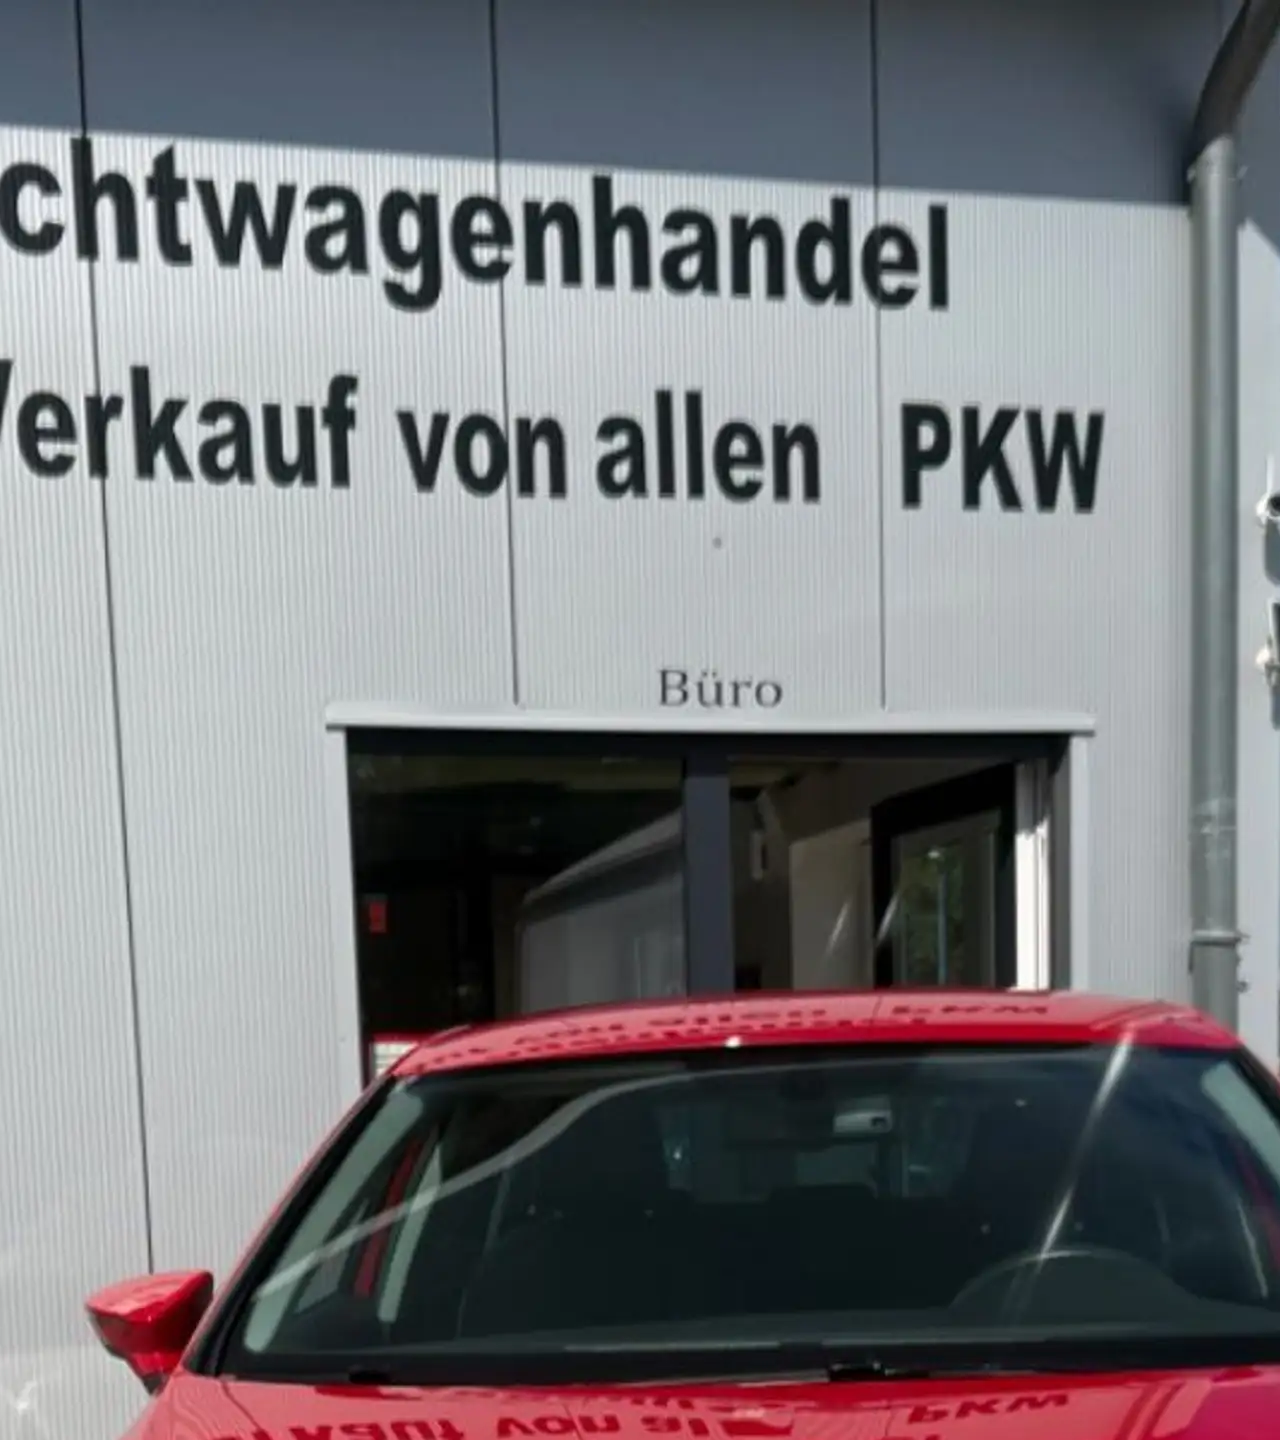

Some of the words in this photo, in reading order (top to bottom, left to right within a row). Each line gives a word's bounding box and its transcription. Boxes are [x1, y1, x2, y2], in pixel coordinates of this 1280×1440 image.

[398, 409, 567, 499] von
[595, 388, 821, 504] allen
[900, 401, 1107, 514] PKW
[658, 669, 784, 708] Büro
